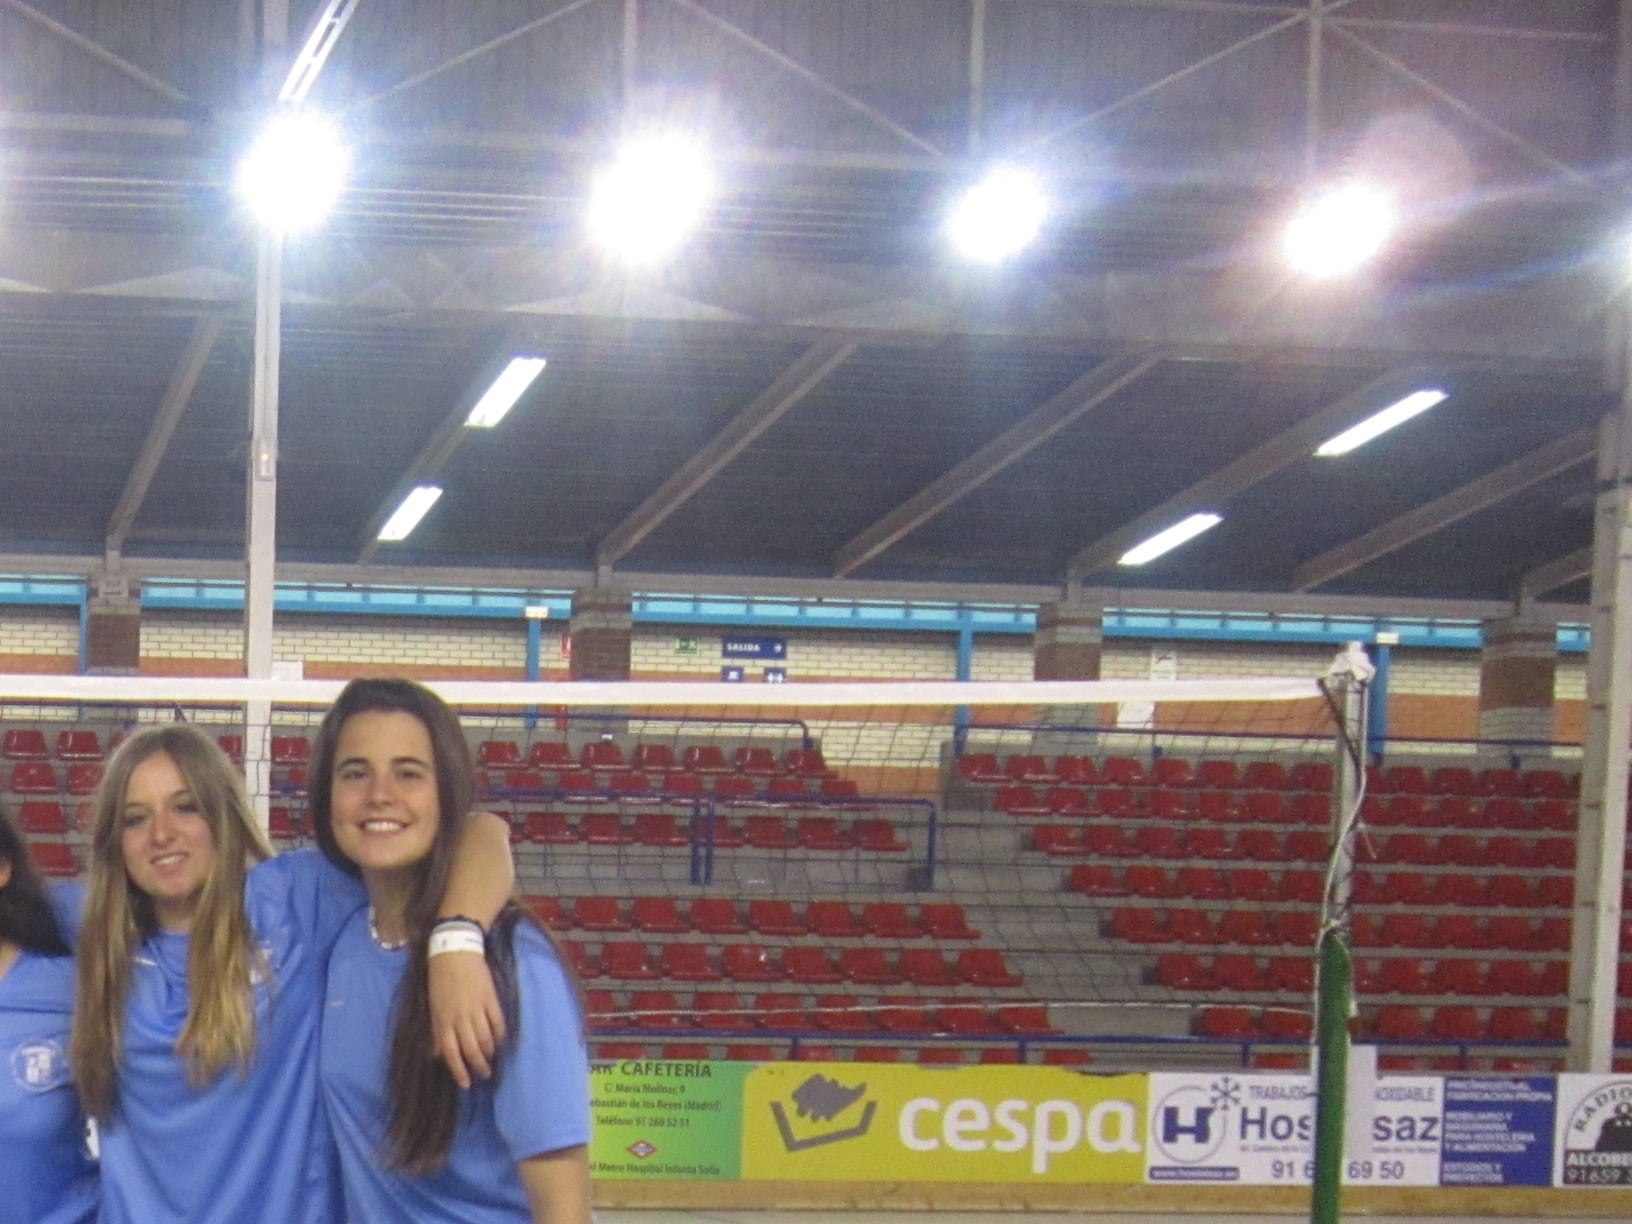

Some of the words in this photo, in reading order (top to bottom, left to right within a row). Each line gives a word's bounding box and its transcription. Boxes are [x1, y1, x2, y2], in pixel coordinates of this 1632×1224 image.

[727, 643, 760, 651] SALIDA
[620, 1060, 712, 1077] CAFETERÍA
[1249, 1085, 1308, 1099] TRABAJOS
[1574, 1086, 1632, 1132] RADIO
[899, 1096, 1142, 1174] cespa
[1272, 1160, 1294, 1178] 91
[1348, 1161, 1373, 1179] 69
[1380, 1161, 1405, 1179] 50
